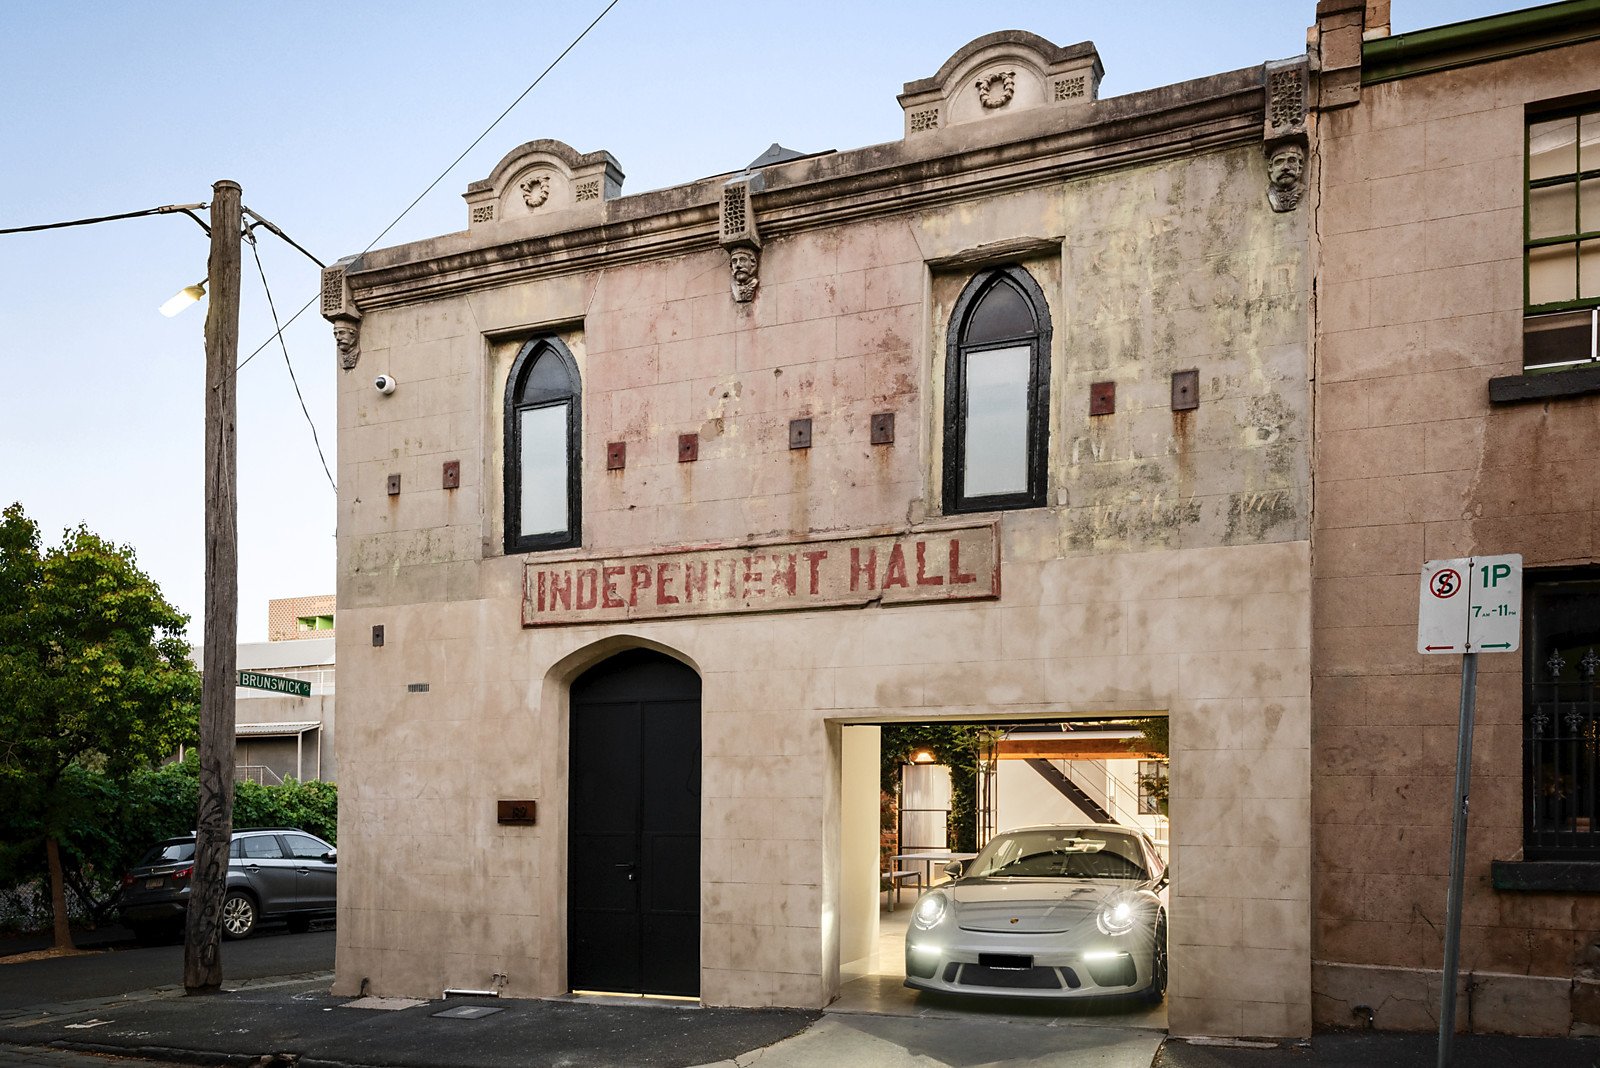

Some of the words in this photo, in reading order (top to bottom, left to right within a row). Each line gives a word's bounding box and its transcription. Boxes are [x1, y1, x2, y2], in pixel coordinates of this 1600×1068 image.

[536, 550, 828, 613] INDEPENDENT
[849, 538, 977, 592] HALL
[1480, 563, 1512, 588] 1P
[242, 673, 301, 694] BRUNSWICK
